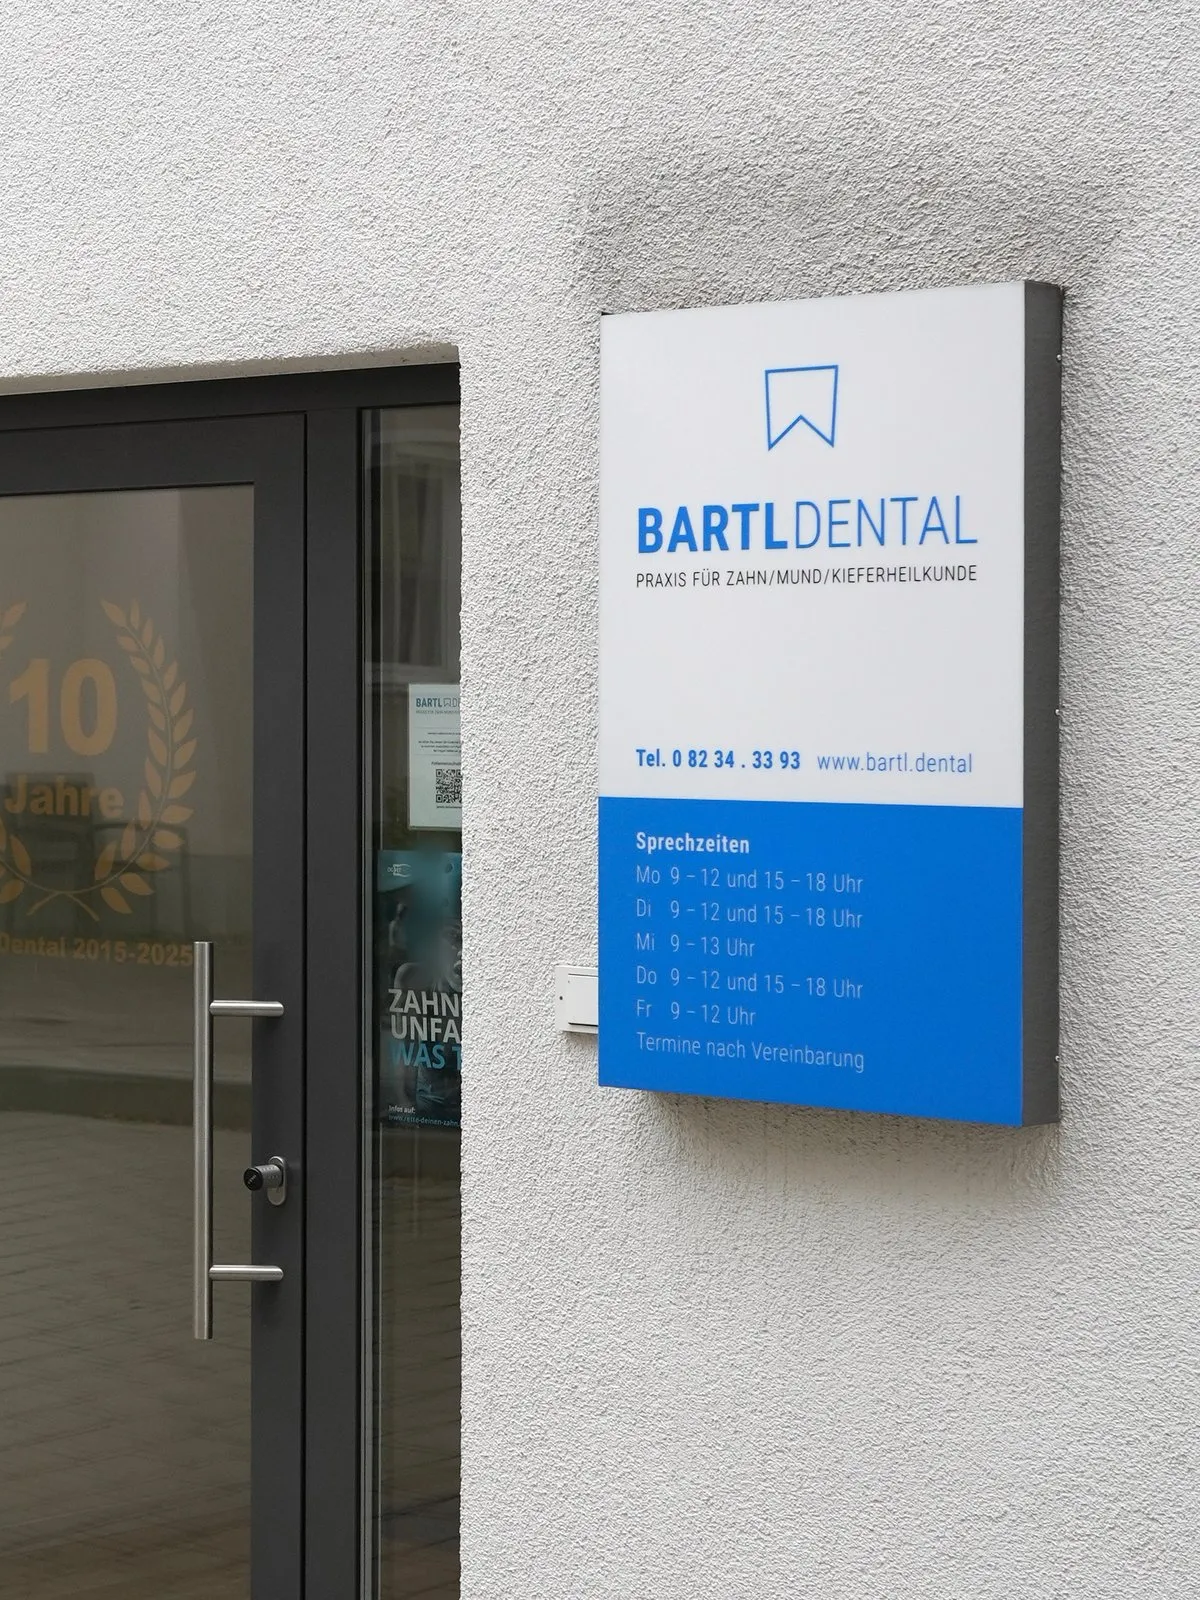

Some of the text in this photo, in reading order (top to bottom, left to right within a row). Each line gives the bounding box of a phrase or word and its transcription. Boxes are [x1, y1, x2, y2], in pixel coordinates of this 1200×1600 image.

[637, 495, 978, 554] BARTLDENTAL
[636, 564, 978, 588] PRAXIS FÜR ZAHN/MUND/KIEFERHEILKUNDE
[9, 658, 118, 756] 10
[636, 748, 666, 768] Tel.
[817, 752, 973, 774] www.bartl.dental
[4, 773, 124, 818] Jahre
[636, 831, 750, 855] Sprechzeiten
[636, 865, 661, 884] Mo
[670, 867, 680, 885] 9
[701, 868, 720, 887] 12
[727, 869, 757, 889] und
[764, 871, 785, 890] 15
[806, 873, 826, 892] 18
[833, 874, 864, 894] Uhr
[636, 899, 652, 917] Di
[670, 900, 680, 919] 9
[701, 902, 720, 921] 12
[727, 904, 757, 923] und
[764, 905, 784, 925] 15
[806, 908, 826, 927] 18
[833, 909, 863, 928] Uhr
[73, 938, 194, 967] 2015-2025
[636, 932, 655, 951] Mi
[670, 934, 680, 952] 9
[701, 936, 720, 955] 13
[727, 937, 756, 957] Uhr
[636, 966, 657, 985] Do
[670, 968, 680, 986] 9
[701, 970, 720, 990] 12
[727, 973, 757, 992] und
[764, 975, 785, 994] 15
[806, 977, 826, 997] 18
[833, 979, 864, 999] Uhr
[388, 988, 460, 1018] ZAHN
[636, 999, 652, 1017] Fr
[670, 1001, 680, 1020] 9
[701, 1004, 720, 1024] 12
[727, 1006, 756, 1026] Uhr
[390, 1041, 445, 1069] WAS
[636, 1031, 864, 1073] Termine nach Vereinbarung
